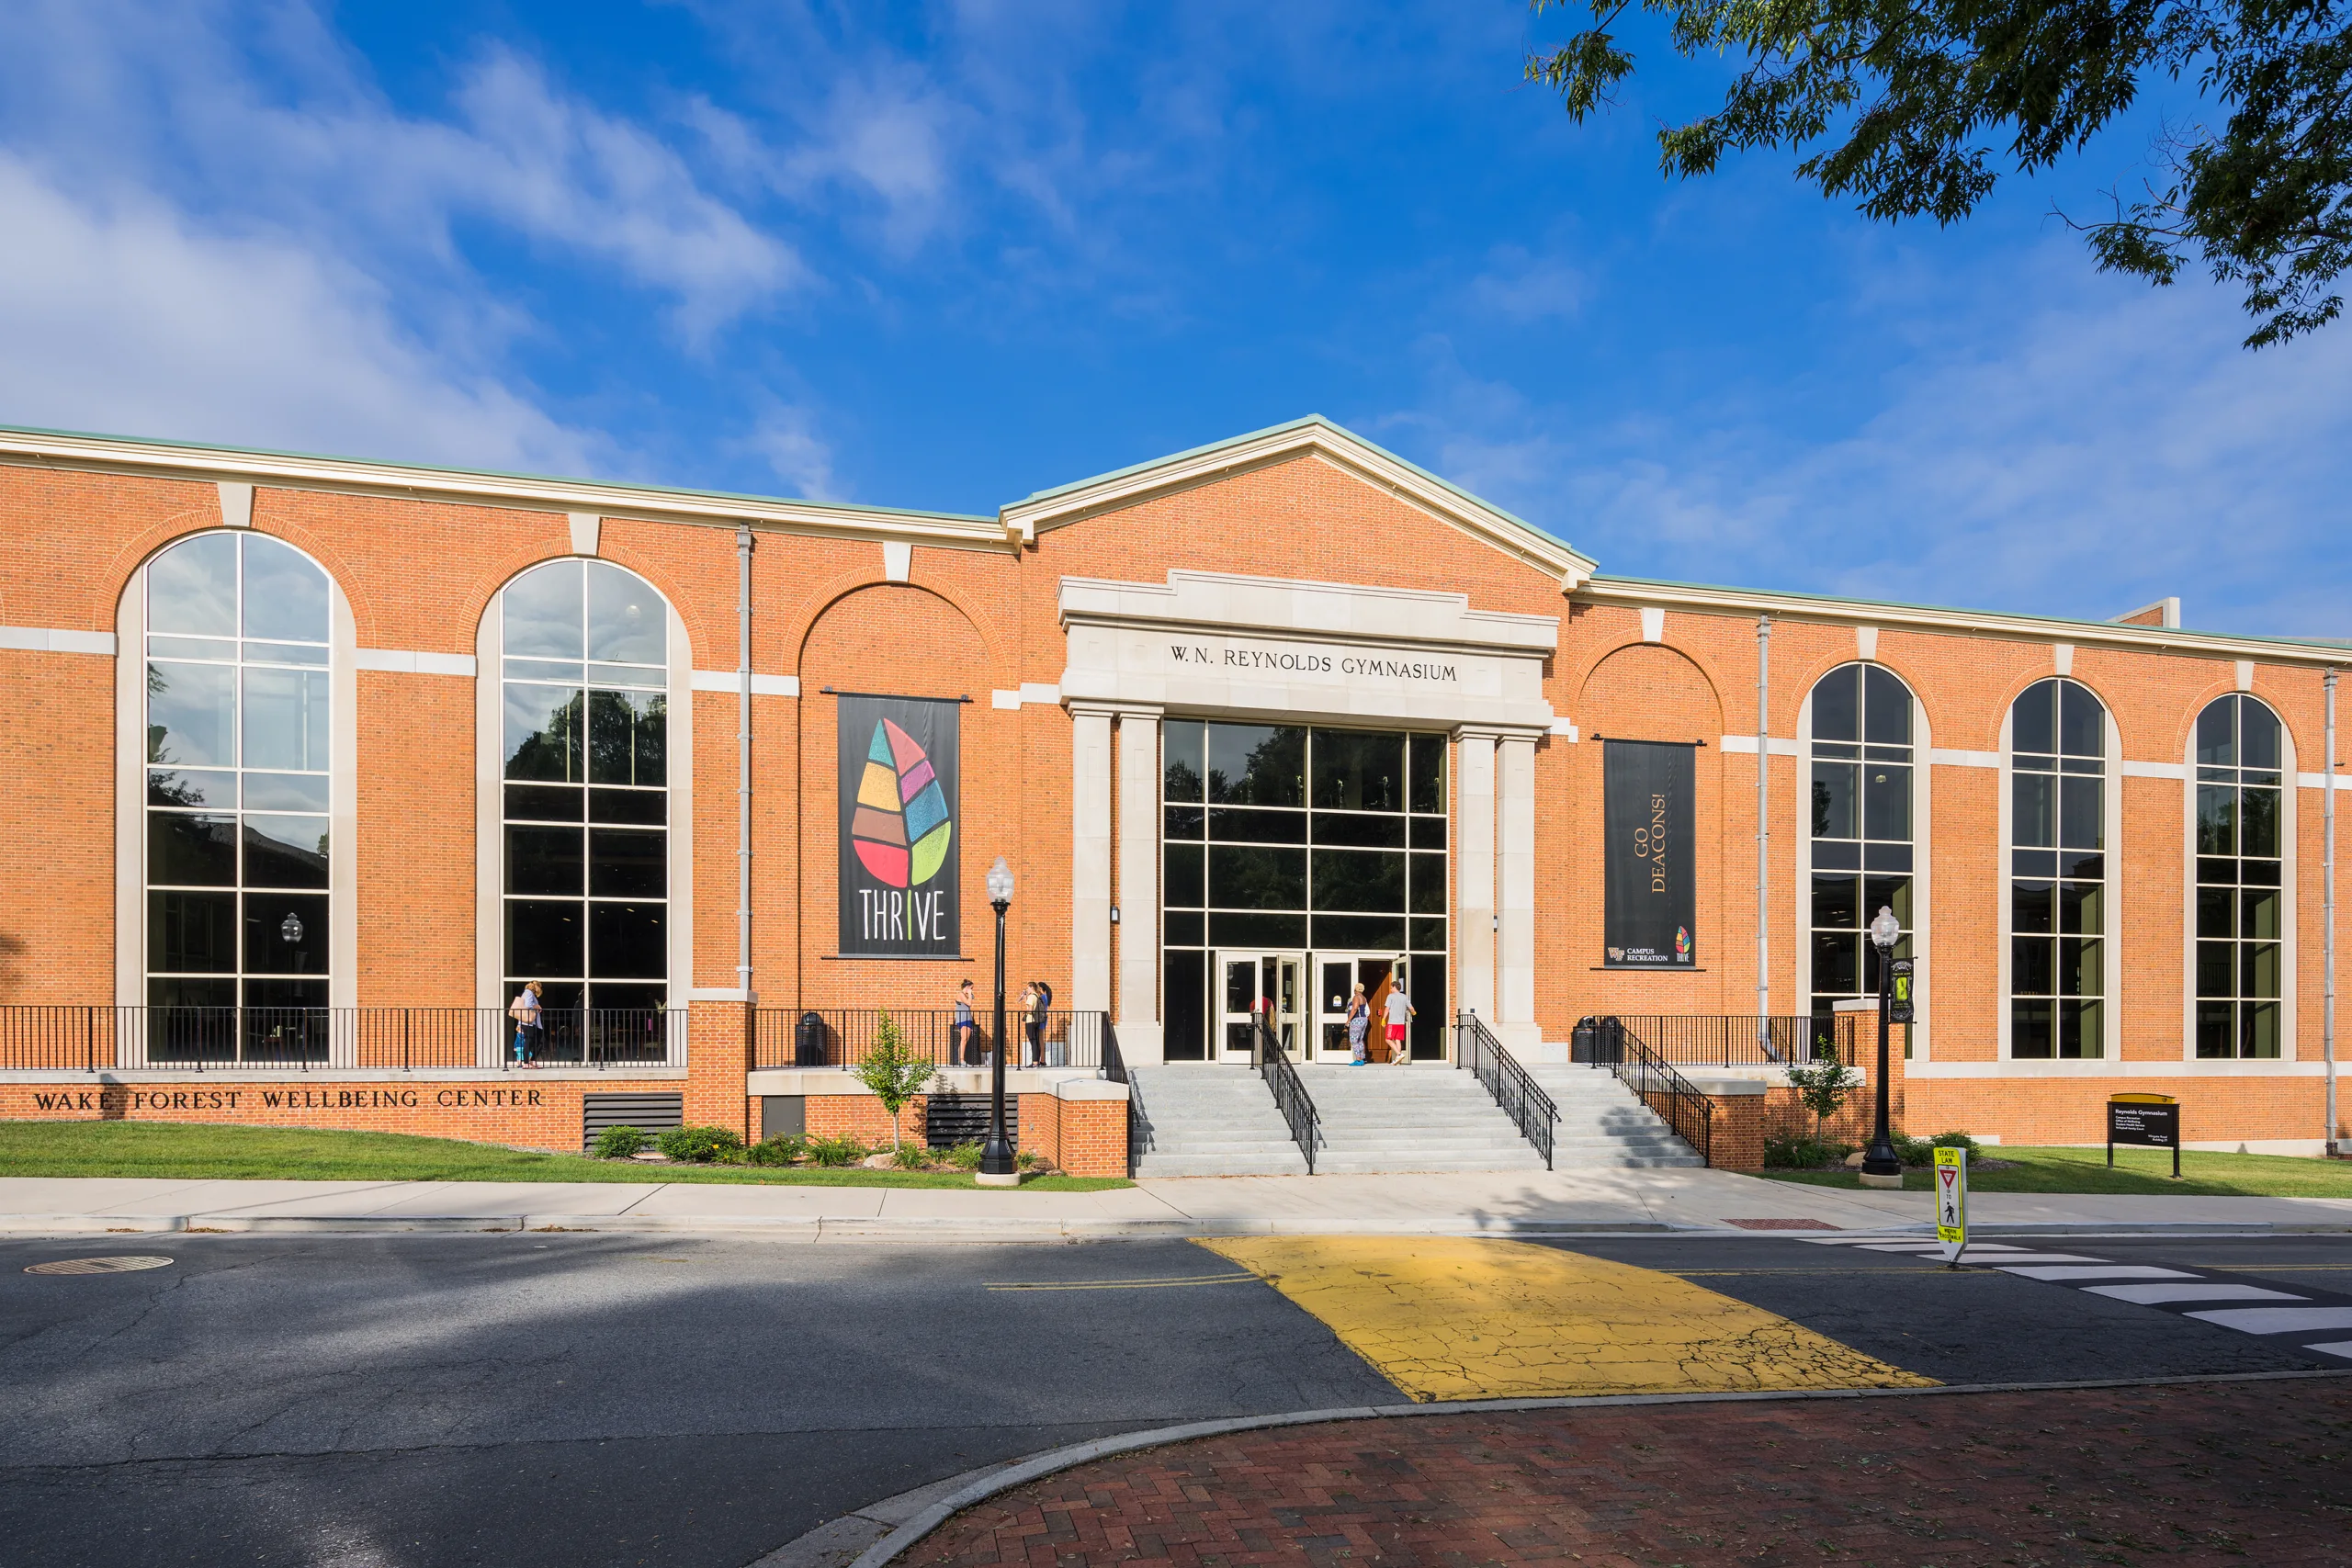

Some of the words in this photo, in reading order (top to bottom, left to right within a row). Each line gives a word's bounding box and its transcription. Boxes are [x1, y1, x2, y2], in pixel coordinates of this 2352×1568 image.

[1224, 649, 1332, 672] REYNOLDS
[1341, 658, 1458, 682] GYMNASIUM
[1634, 828, 1649, 858] GO
[1652, 794, 1666, 894] DEACONS!
[859, 889, 946, 941] THRIVE
[33, 1092, 114, 1110] WAKE
[133, 1091, 242, 1109] FOREST
[263, 1090, 419, 1108] WELLBEING
[437, 1089, 543, 1107] CENTER
